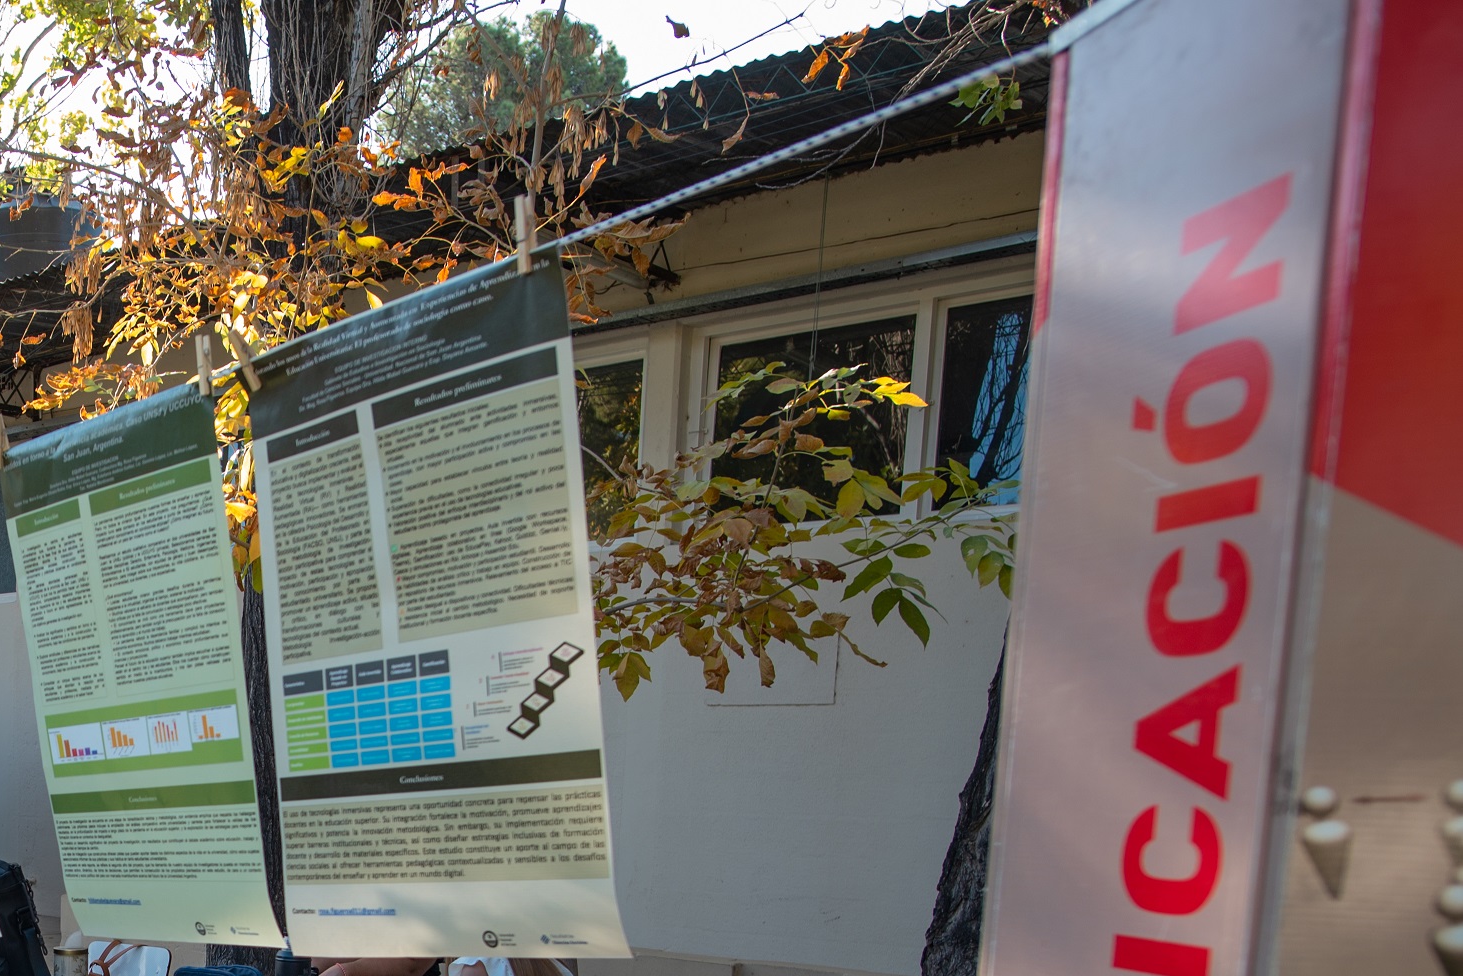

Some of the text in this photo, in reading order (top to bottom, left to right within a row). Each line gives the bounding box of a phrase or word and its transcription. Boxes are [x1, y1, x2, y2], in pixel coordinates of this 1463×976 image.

[63, 436, 124, 462] San Juan, Argentina.
[300, 809, 307, 817] de
[342, 806, 371, 814] inmersivas
[374, 804, 406, 813] representa
[423, 800, 462, 810] oportunidad
[465, 798, 494, 807] concreta
[497, 797, 514, 806] para
[551, 793, 562, 801] las
[565, 790, 601, 800] prácticas
[325, 817, 352, 826] educación
[382, 815, 390, 823] Su
[393, 814, 426, 823] integración
[429, 812, 458, 821] fortalece
[460, 811, 466, 819] la
[512, 806, 549, 817] promueve
[552, 803, 601, 814] aprendizajes
[326, 828, 350, 839] potencia
[361, 826, 393, 835] innovación
[444, 823, 454, 831] Sin
[458, 822, 490, 831] embargo,
[506, 818, 565, 829] implementación
[569, 816, 603, 826] requiere
[333, 839, 372, 848] institucionales
[411, 836, 419, 844] así
[444, 834, 468, 843] diseñar
[472, 832, 510, 842] estrategias
[512, 830, 547, 840] inclusivas
[550, 830, 559, 838] de
[563, 828, 604, 837] formación
[352, 849, 383, 858] materiales
[439, 846, 463, 855] estudio
[466, 843, 501, 854] constituye
[516, 843, 539, 853] aporte
[552, 842, 577, 851] campo
[580, 841, 589, 849] de
[593, 840, 604, 848] las
[340, 860, 360, 869] ofrecer
[363, 859, 403, 867] herramientas
[406, 858, 445, 867] pedagógicas
[448, 856, 504, 866] contextualizadas
[515, 854, 547, 863] sensibles
[558, 854, 569, 862] los
[573, 851, 606, 861] desafíos
[343, 871, 365, 879] enseñar
[372, 871, 398, 880] aprender
[420, 869, 441, 877] mundo
[443, 869, 465, 878] digital.
